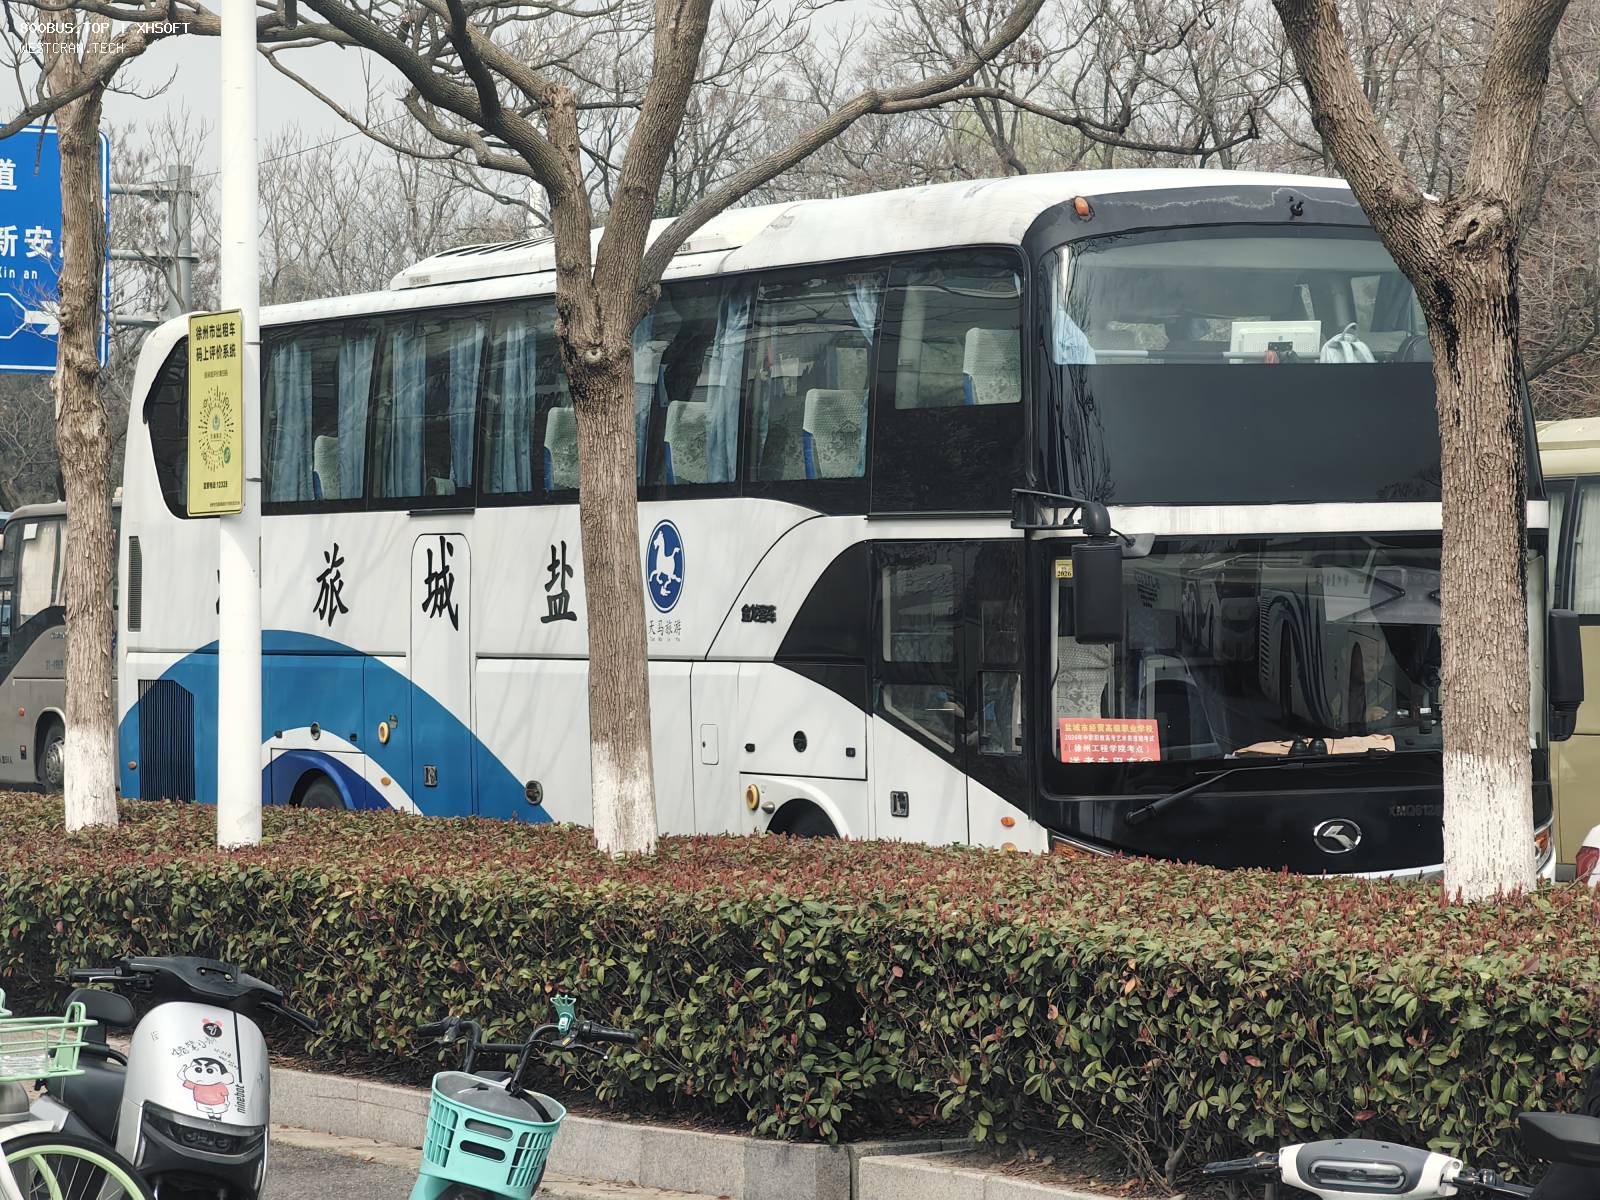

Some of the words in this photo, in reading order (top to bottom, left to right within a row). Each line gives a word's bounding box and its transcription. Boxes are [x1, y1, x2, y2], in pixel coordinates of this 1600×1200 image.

[23, 269, 38, 280] an
[195, 321, 236, 341] 徐州市出租车
[195, 343, 236, 362] 码上评价系统
[648, 619, 682, 636] 天马旅游
[234, 1083, 246, 1114] ninebot
